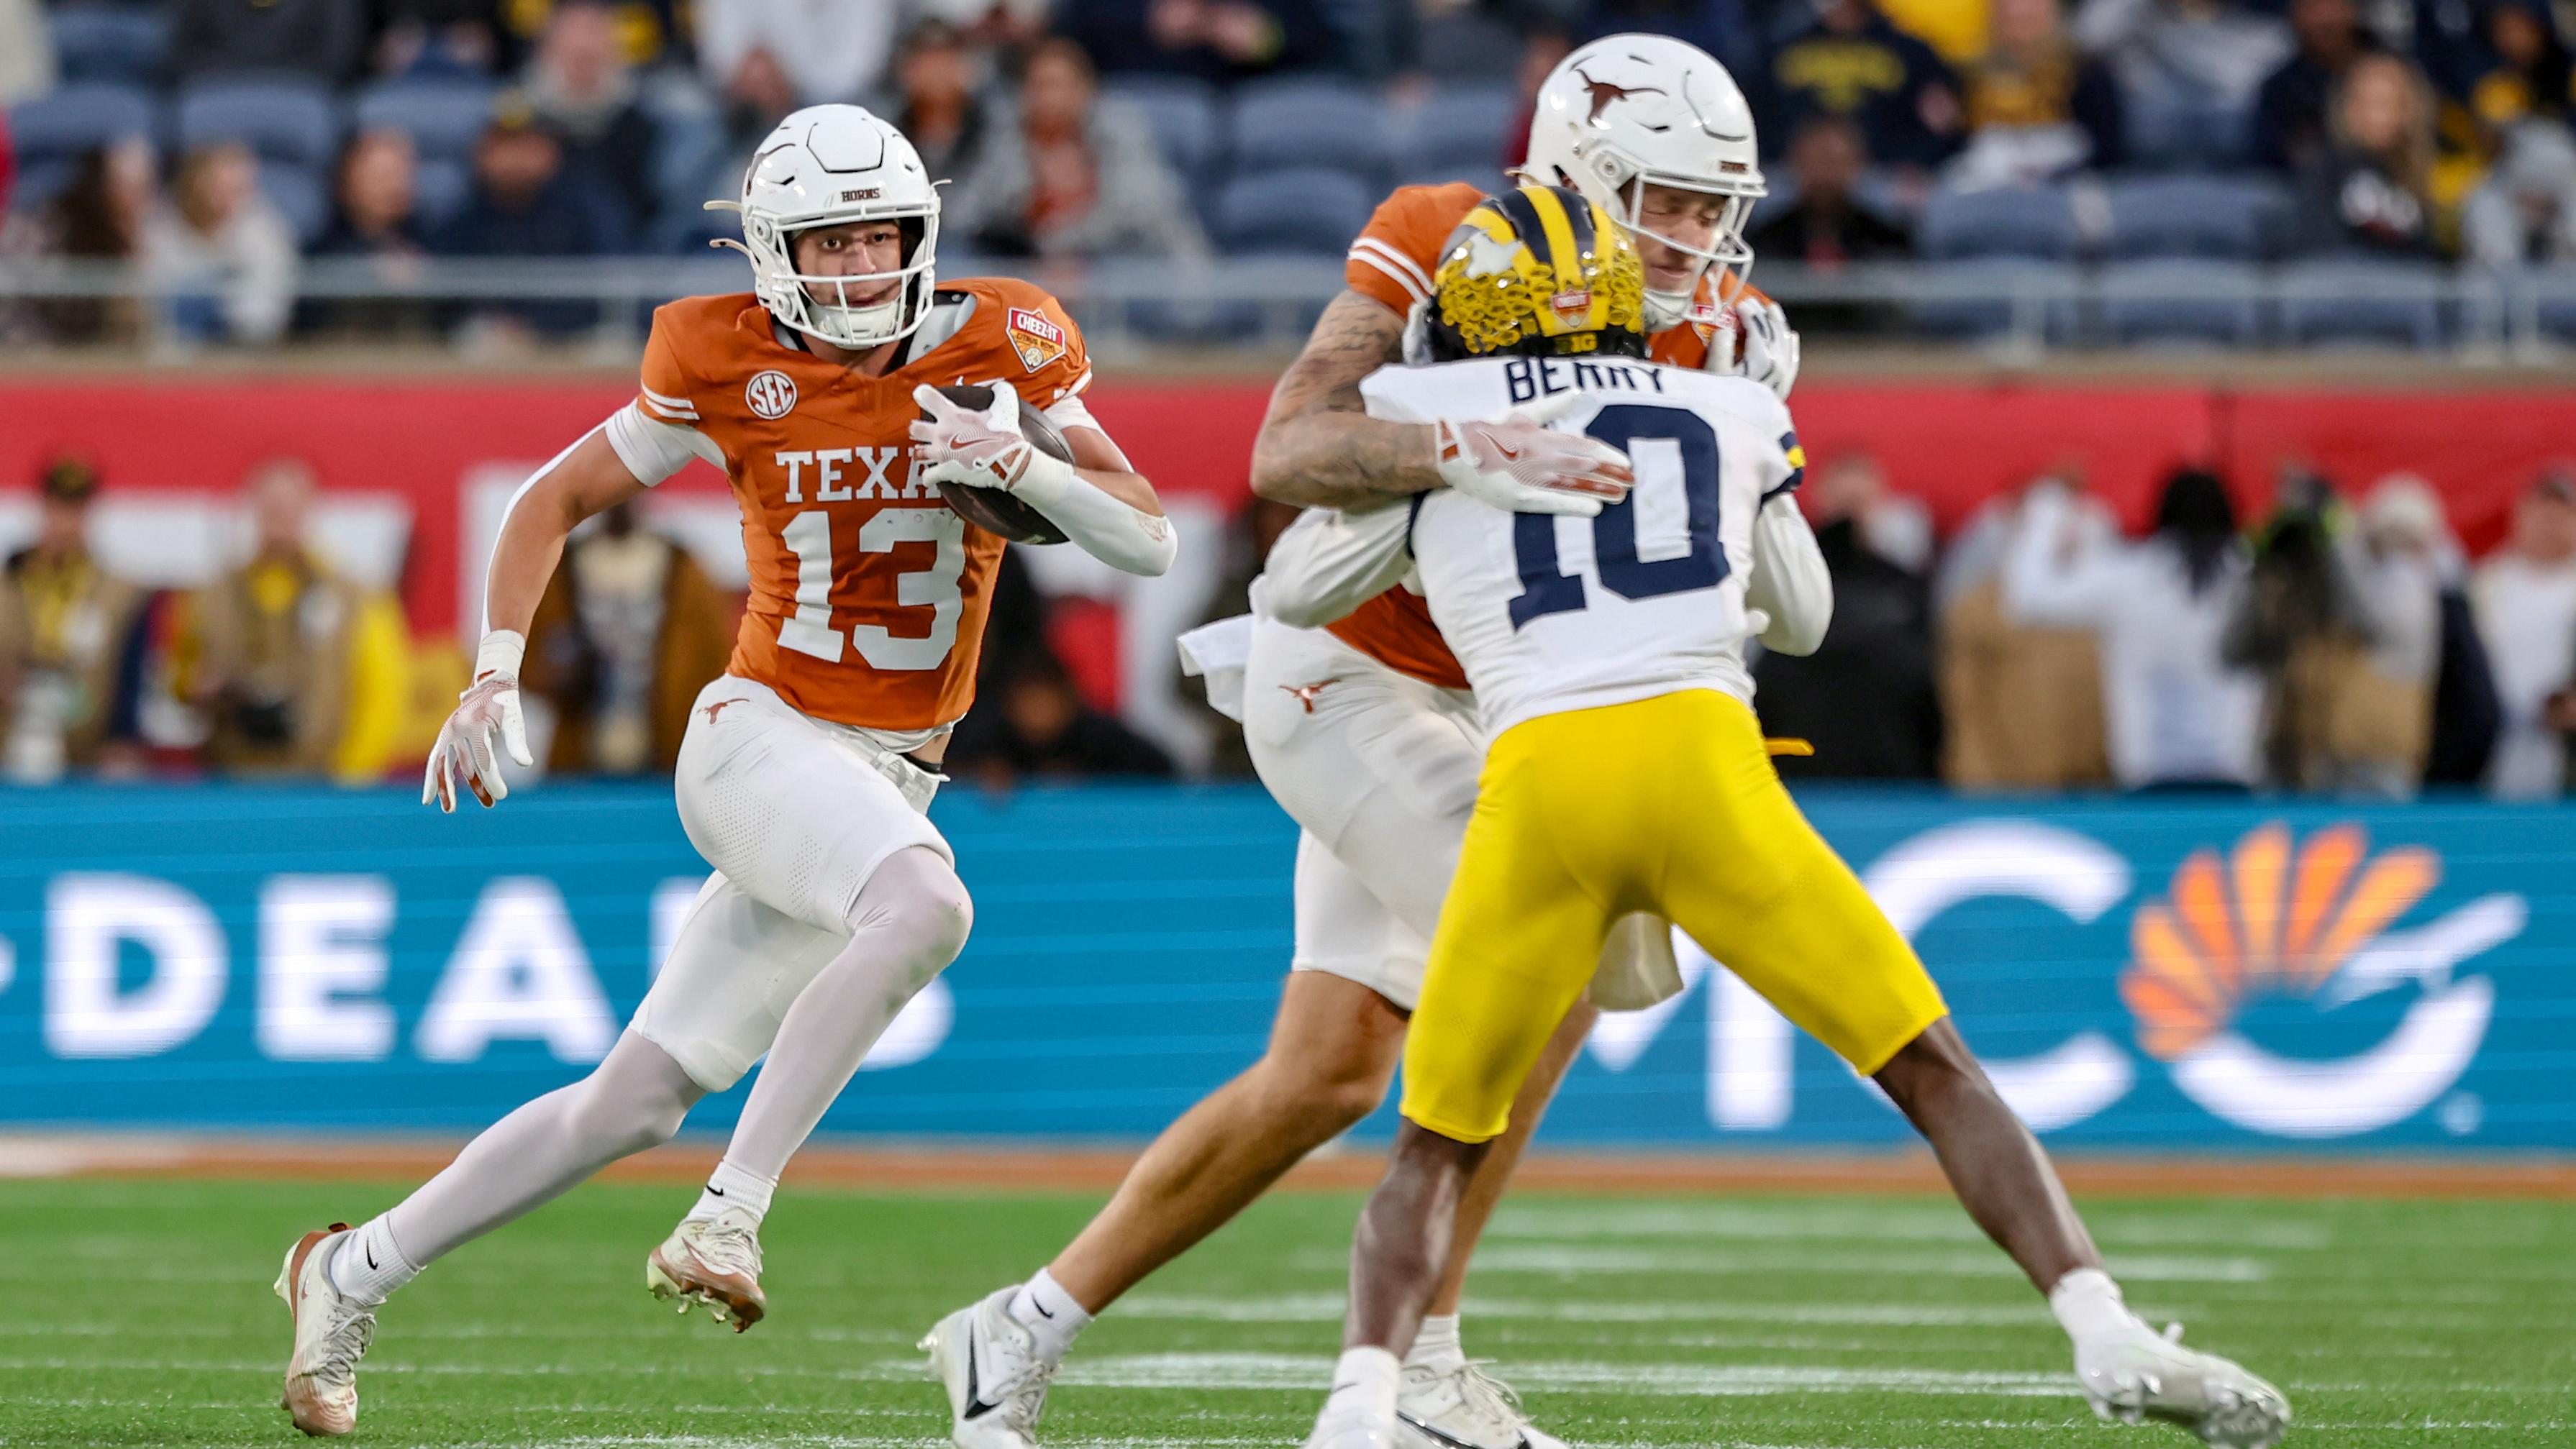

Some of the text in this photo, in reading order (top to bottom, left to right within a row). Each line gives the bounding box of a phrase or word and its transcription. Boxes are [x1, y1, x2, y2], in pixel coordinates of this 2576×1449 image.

[841, 188, 880, 202] HORNS
[1016, 314, 1059, 342] CHEEZ-IT
[750, 375, 793, 416] SEC
[775, 446, 942, 503] TEXA
[777, 508, 965, 670] 13
[45, 872, 955, 1069] DEA
